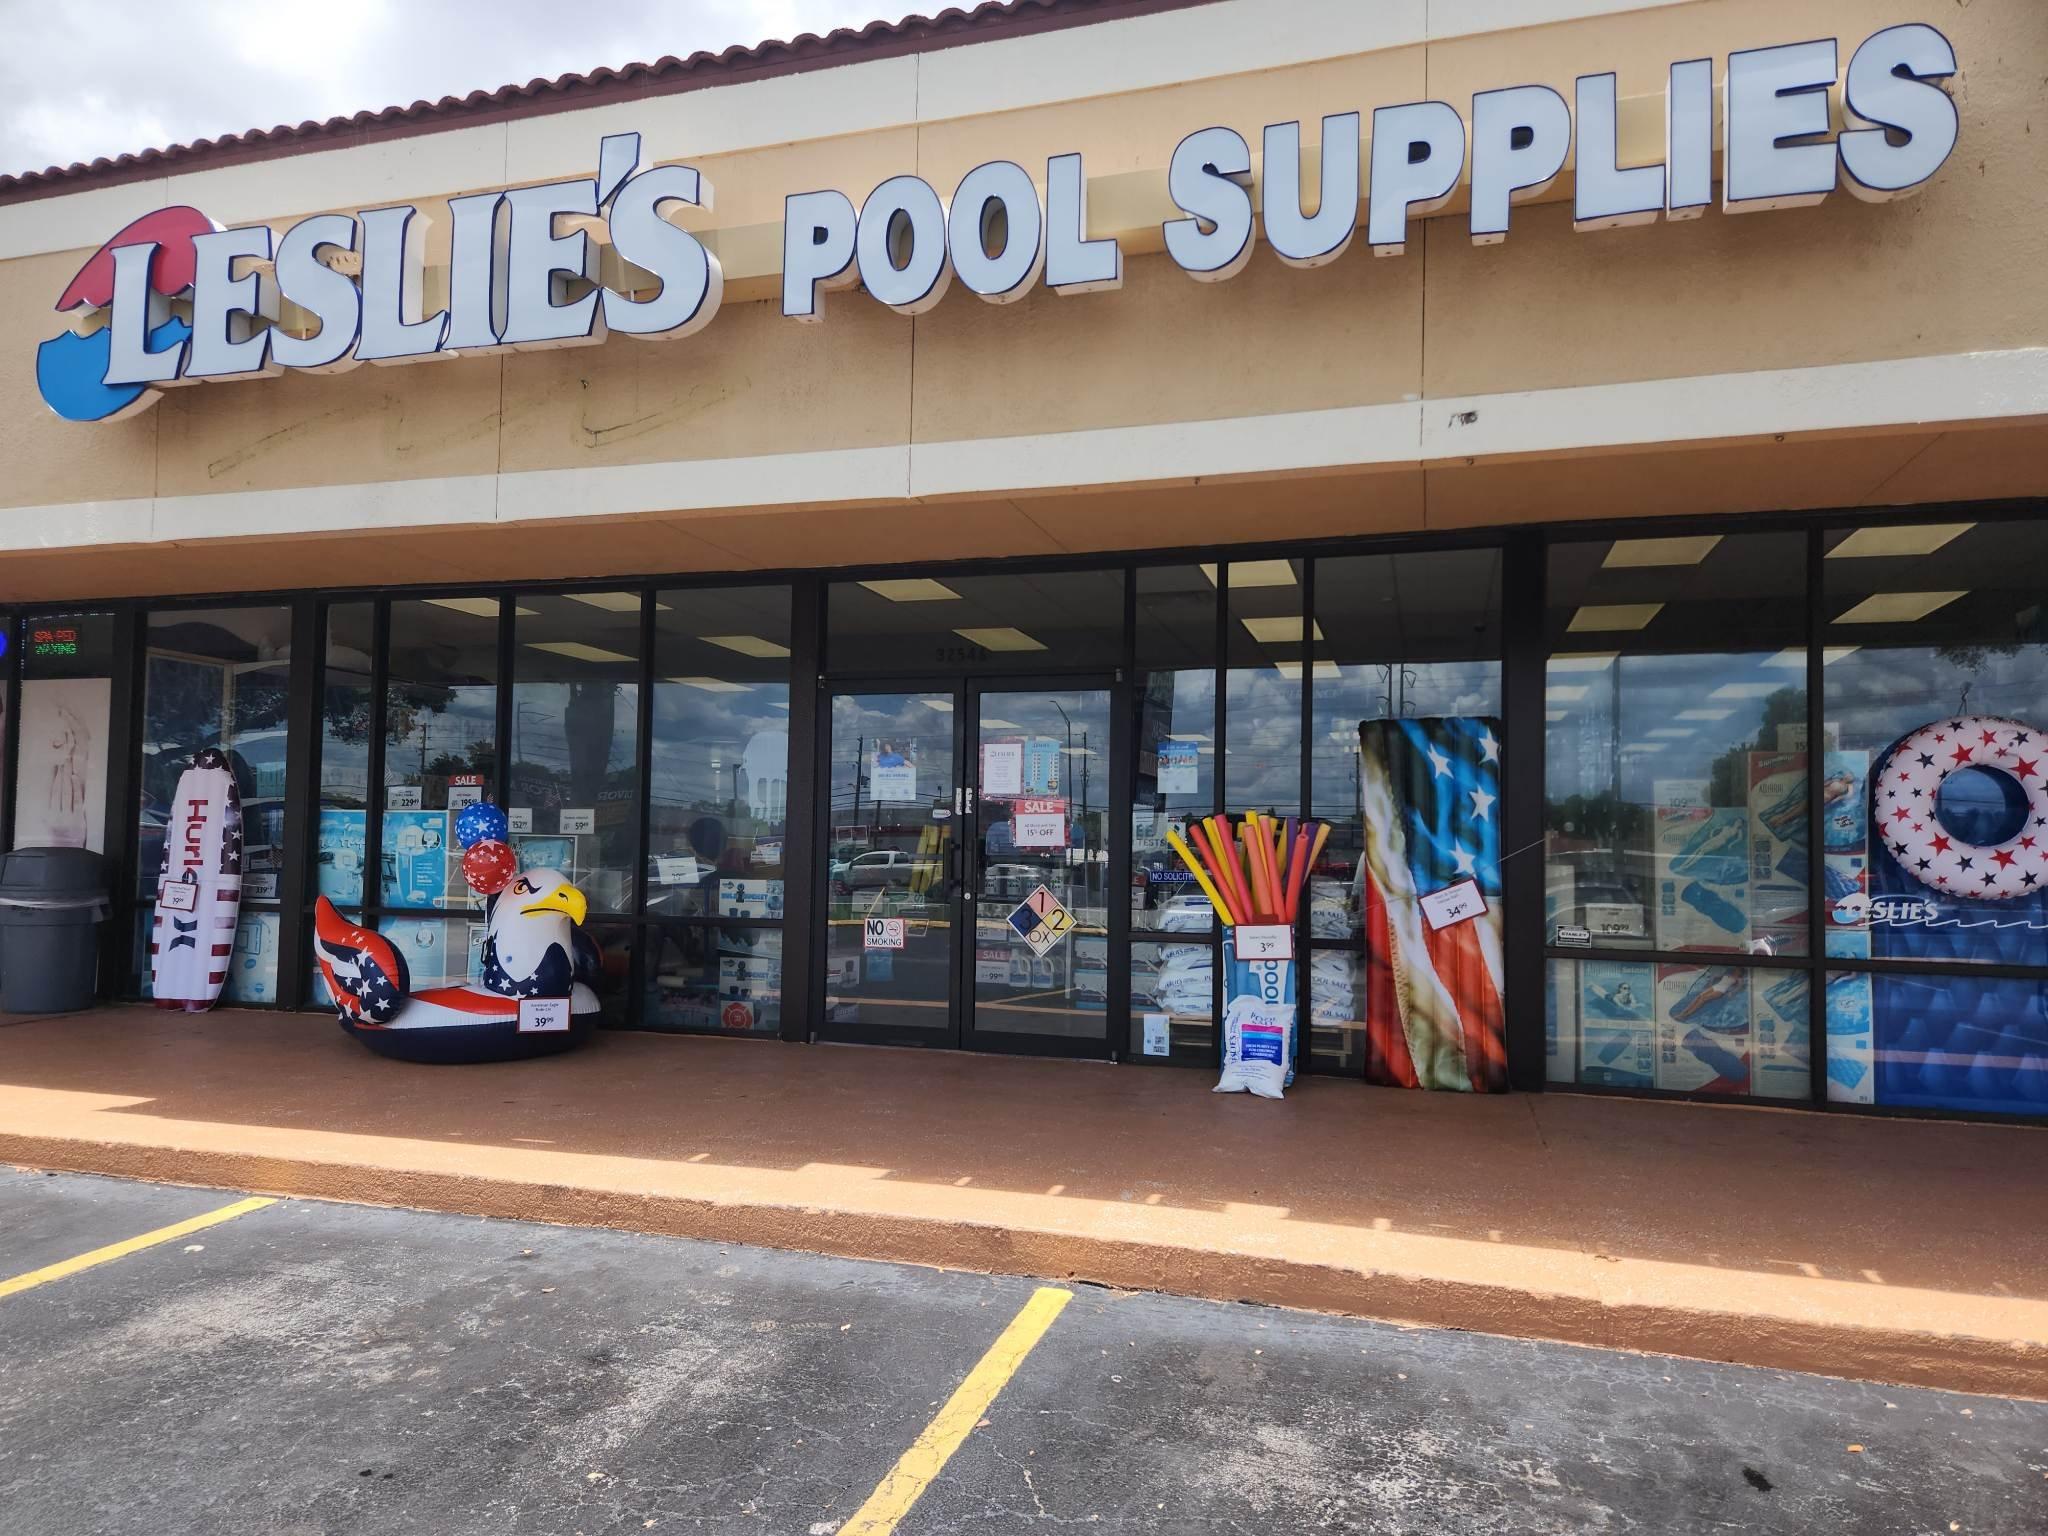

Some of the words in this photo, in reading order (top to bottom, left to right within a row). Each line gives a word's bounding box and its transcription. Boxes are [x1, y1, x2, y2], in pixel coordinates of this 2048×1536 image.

[103, 132, 714, 386] LESLIE'S
[782, 152, 1119, 318] POOL
[1163, 22, 1959, 274] SUPPLIES
[455, 775, 477, 785] SALE
[1024, 801, 1054, 813] SALE
[1039, 828, 1054, 836] OFF
[1138, 838, 1167, 847] TESTS
[1152, 872, 1162, 880] NO
[1163, 872, 1195, 881] SOLICITIN
[1038, 891, 1045, 913] 1
[1019, 908, 1032, 929] 3
[1052, 908, 1065, 930] 2
[867, 919, 884, 935] NO
[1029, 929, 1050, 943] OX
[866, 937, 902, 946] SMOKING
[1259, 942, 1275, 952] 399
[983, 951, 1006, 960] SALE
[534, 1016, 554, 1027] 3999
